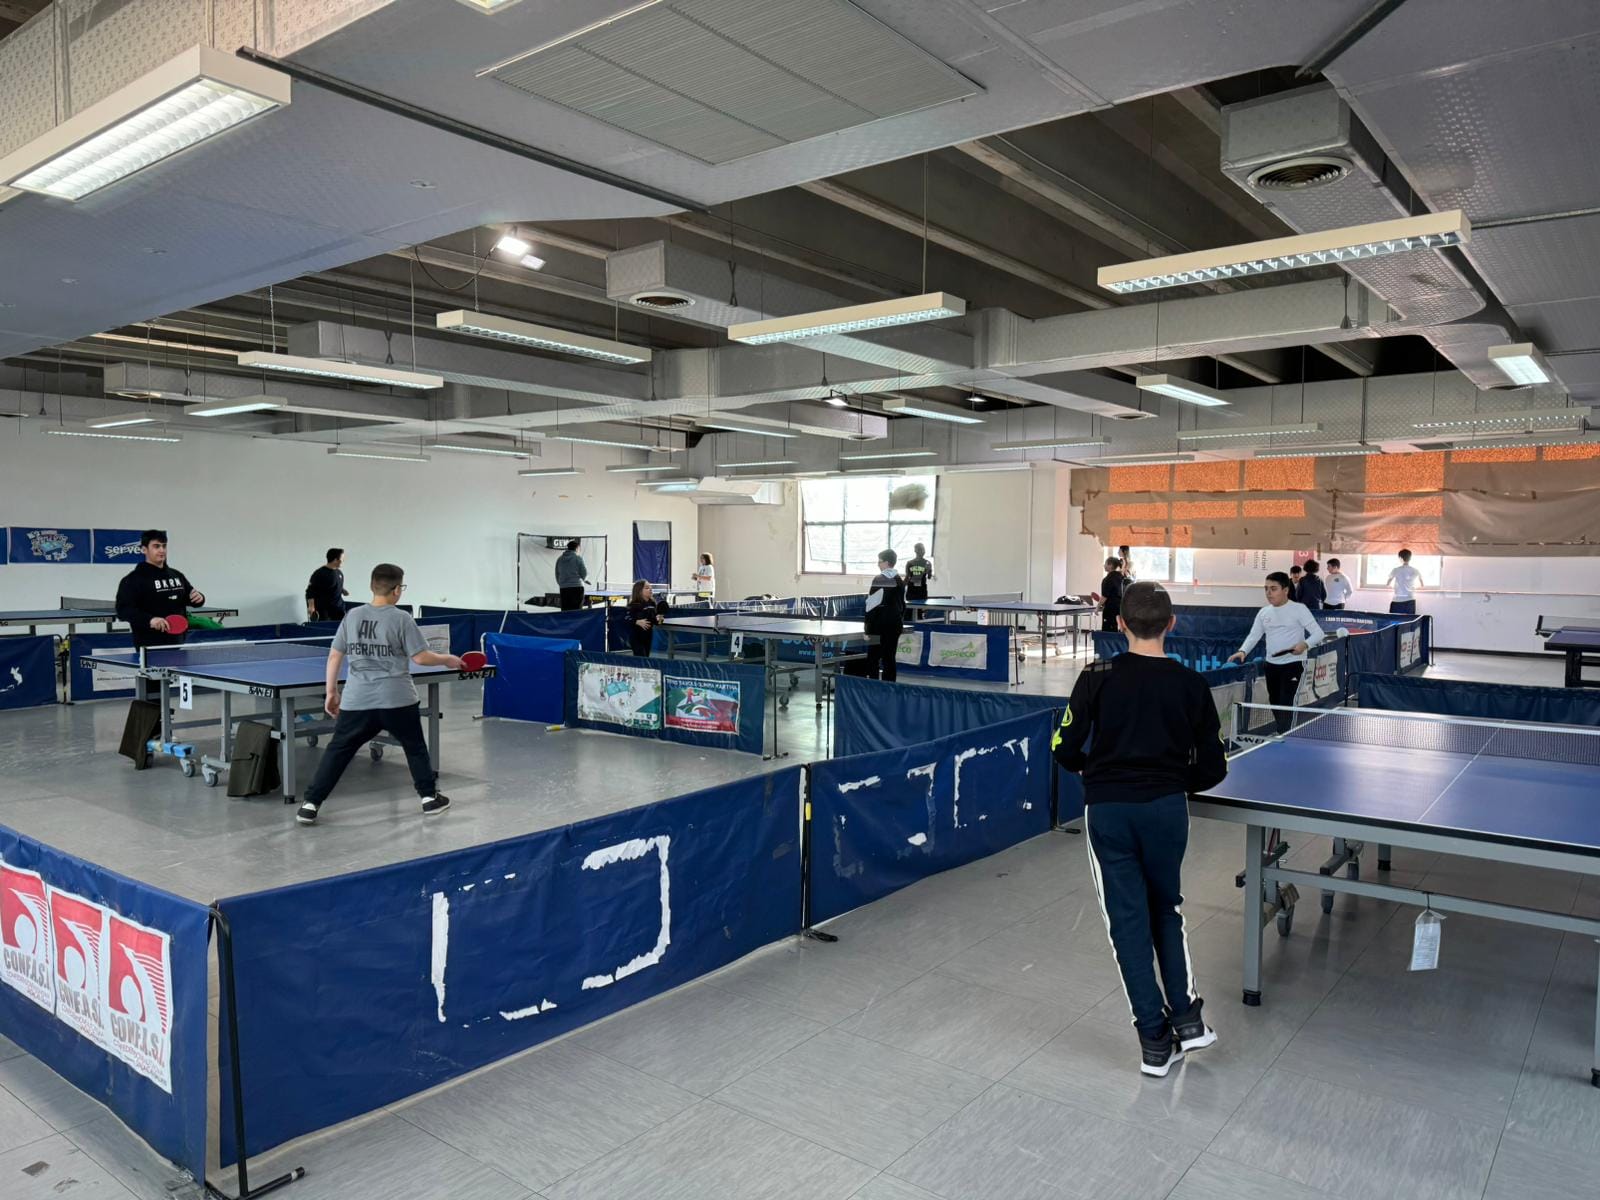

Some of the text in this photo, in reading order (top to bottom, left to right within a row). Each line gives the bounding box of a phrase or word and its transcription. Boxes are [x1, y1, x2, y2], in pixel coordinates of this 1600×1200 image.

[358, 619, 379, 640] AK
[734, 636, 740, 649] 4
[182, 683, 188, 702] 5
